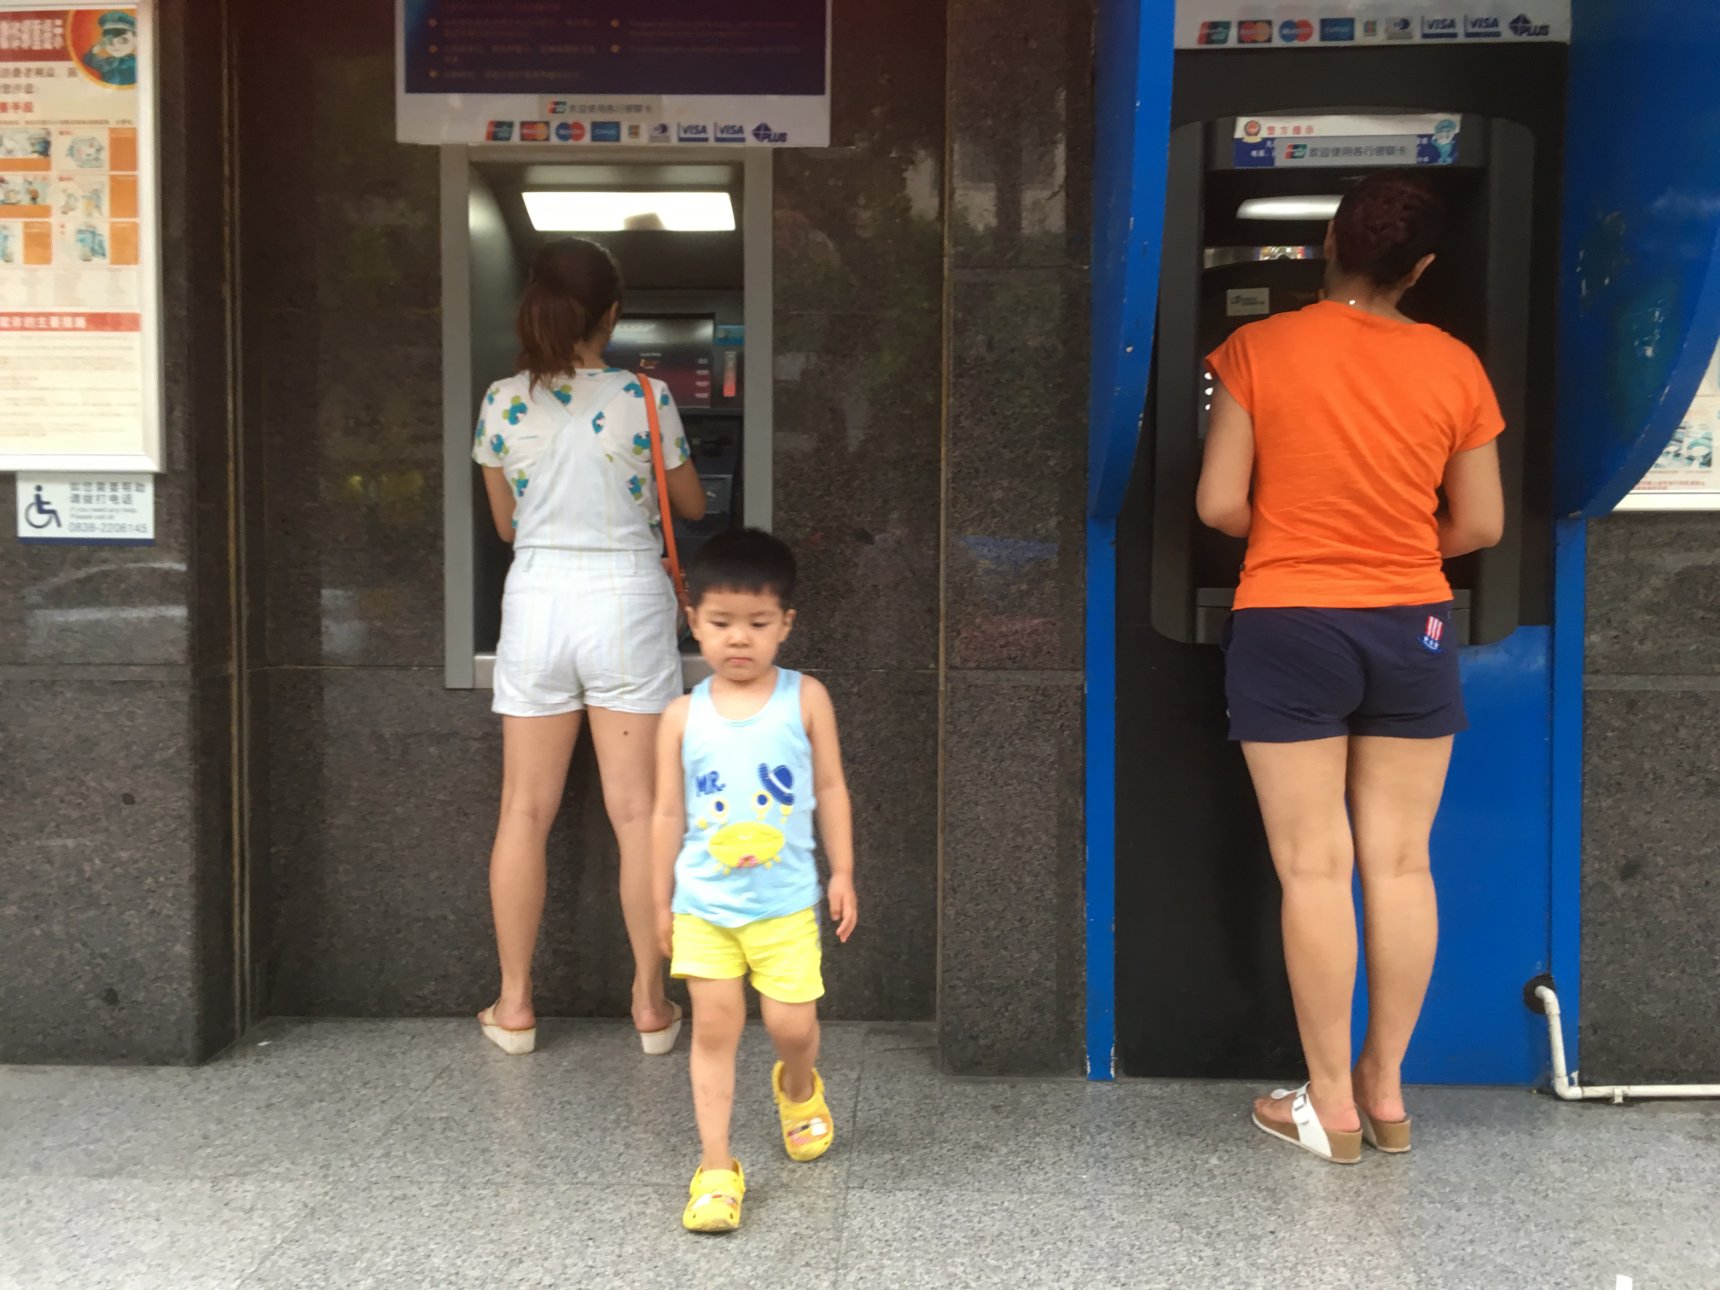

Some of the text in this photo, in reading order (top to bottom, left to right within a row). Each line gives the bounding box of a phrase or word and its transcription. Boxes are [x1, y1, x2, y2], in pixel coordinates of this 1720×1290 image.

[1427, 17, 1499, 30] VISA VISA
[681, 124, 745, 135] VISA VISA
